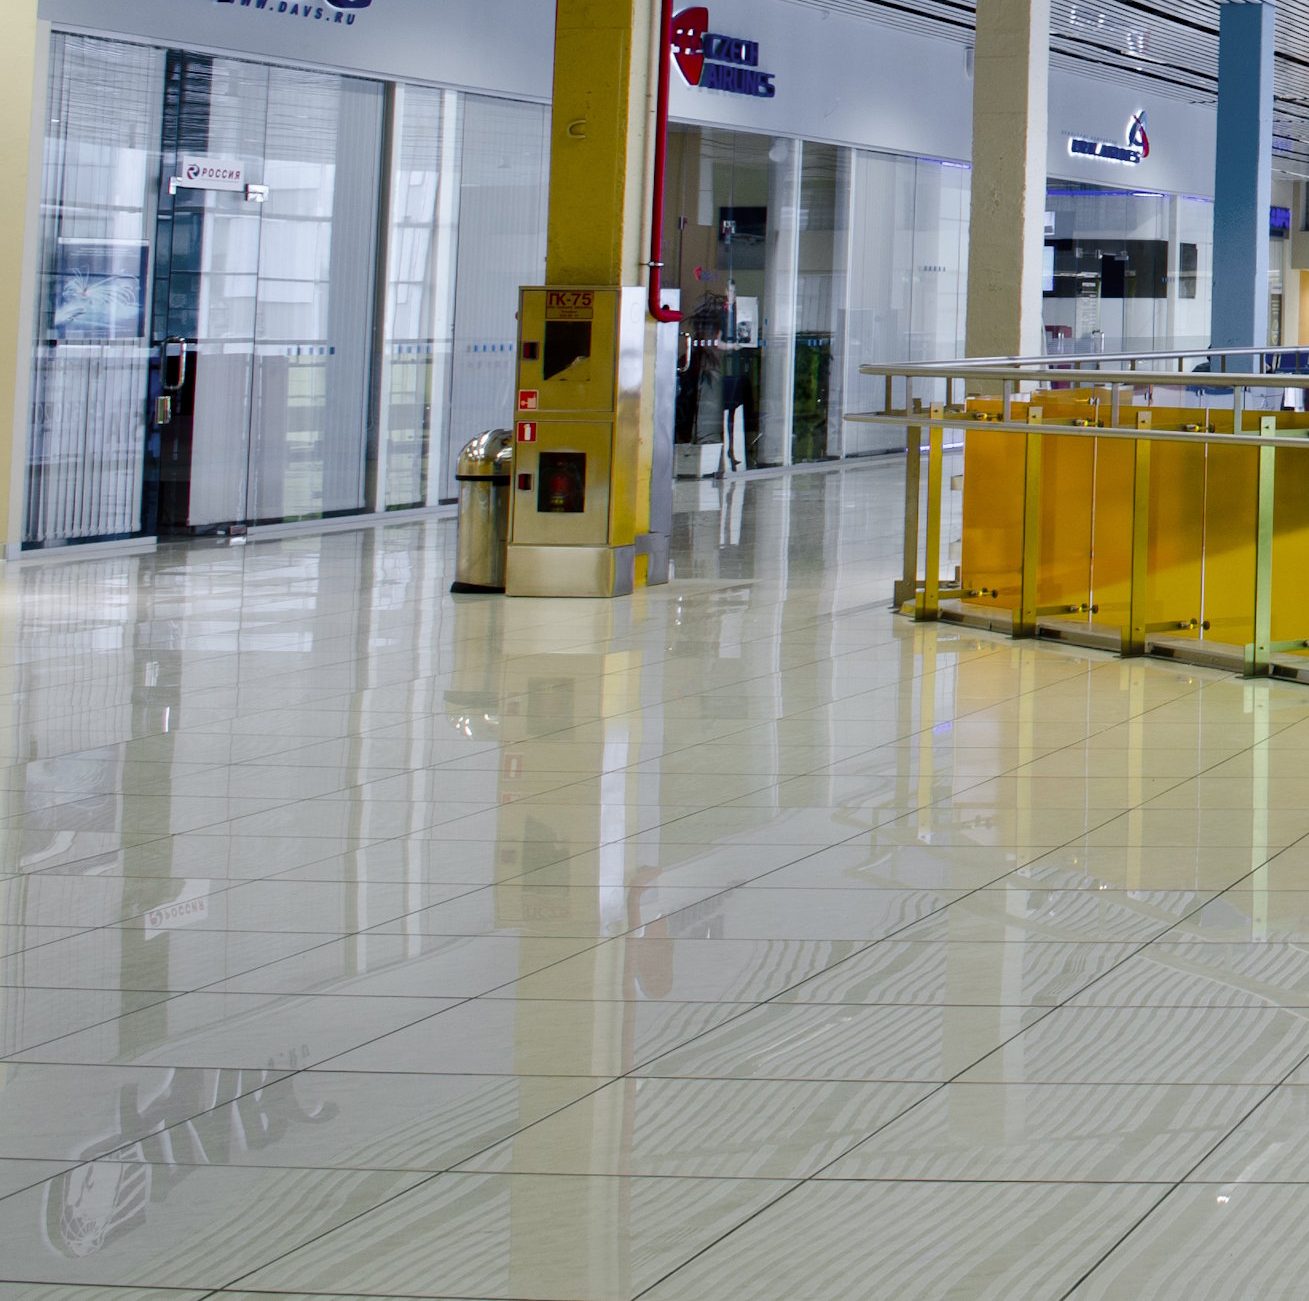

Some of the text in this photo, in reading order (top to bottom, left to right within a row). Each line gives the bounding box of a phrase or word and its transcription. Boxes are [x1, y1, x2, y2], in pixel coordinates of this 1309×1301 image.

[703, 33, 759, 67] CZECH
[700, 62, 776, 98] AIRLINES
[201, 168, 241, 180] РОССИЯ
